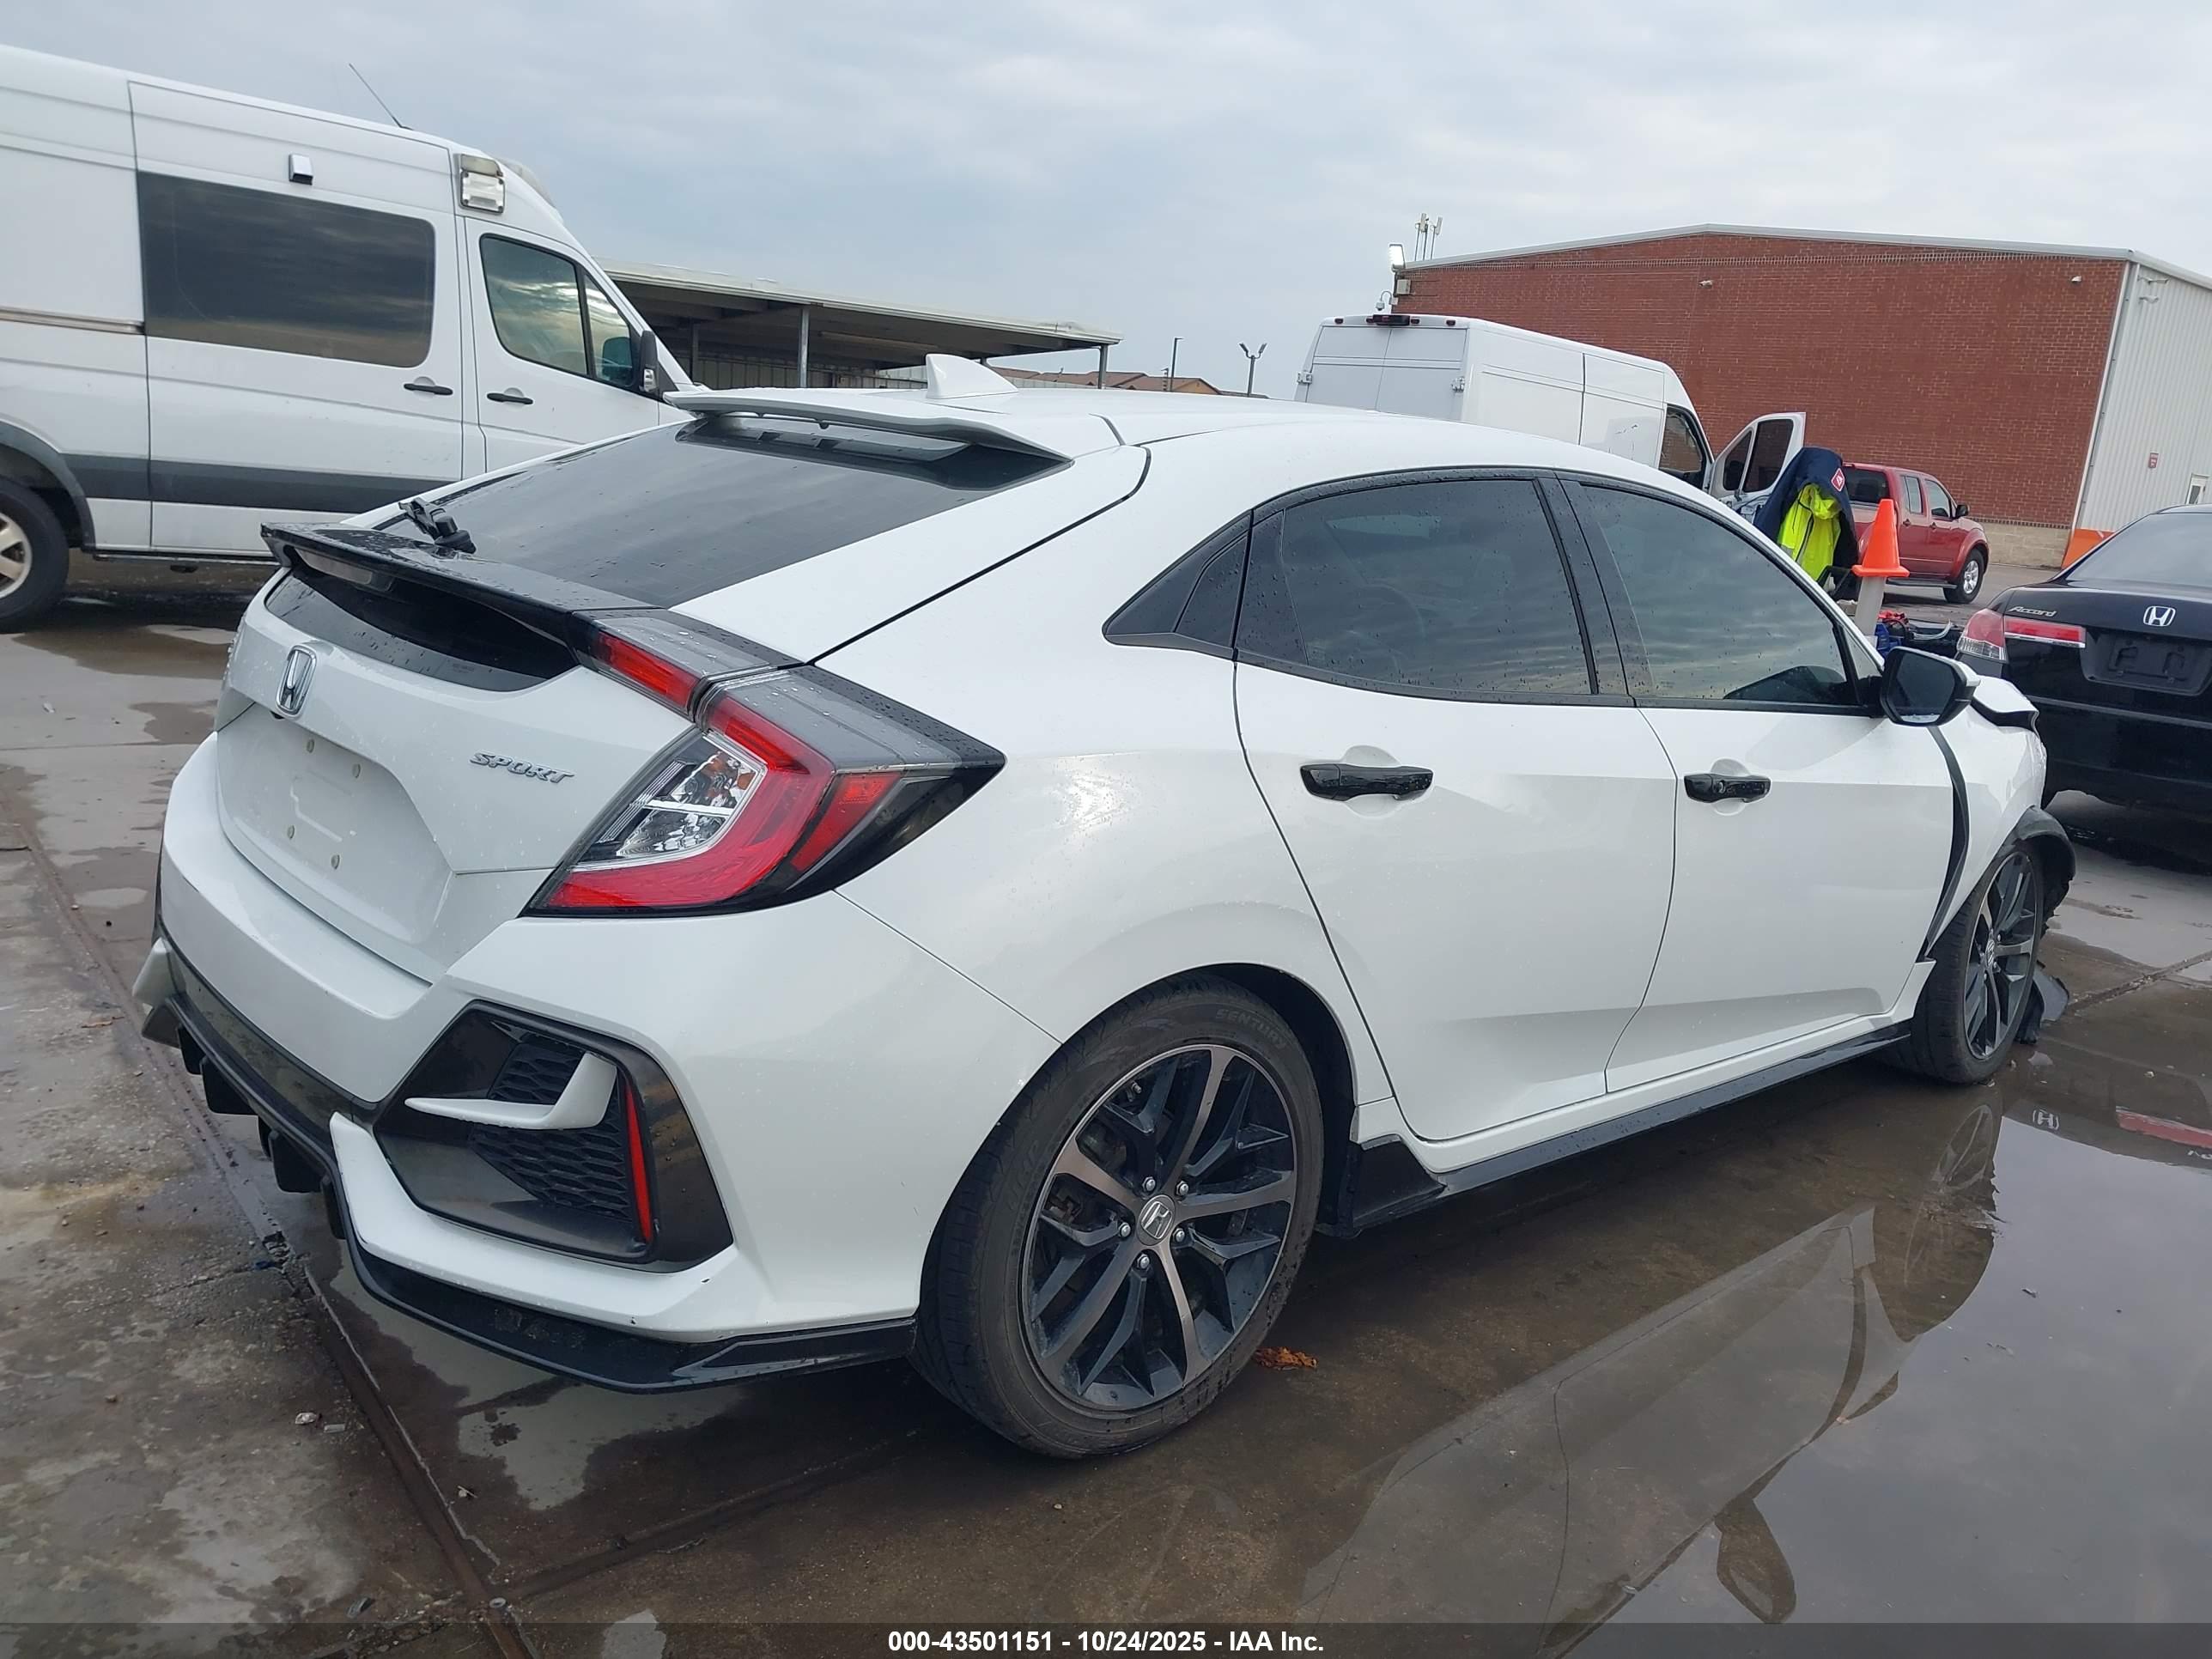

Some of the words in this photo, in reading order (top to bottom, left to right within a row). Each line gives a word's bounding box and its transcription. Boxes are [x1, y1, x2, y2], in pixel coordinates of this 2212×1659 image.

[2008, 605, 2057, 617] Accord
[469, 750, 575, 784] SPORT
[1214, 1007, 1288, 1050] SENTURY
